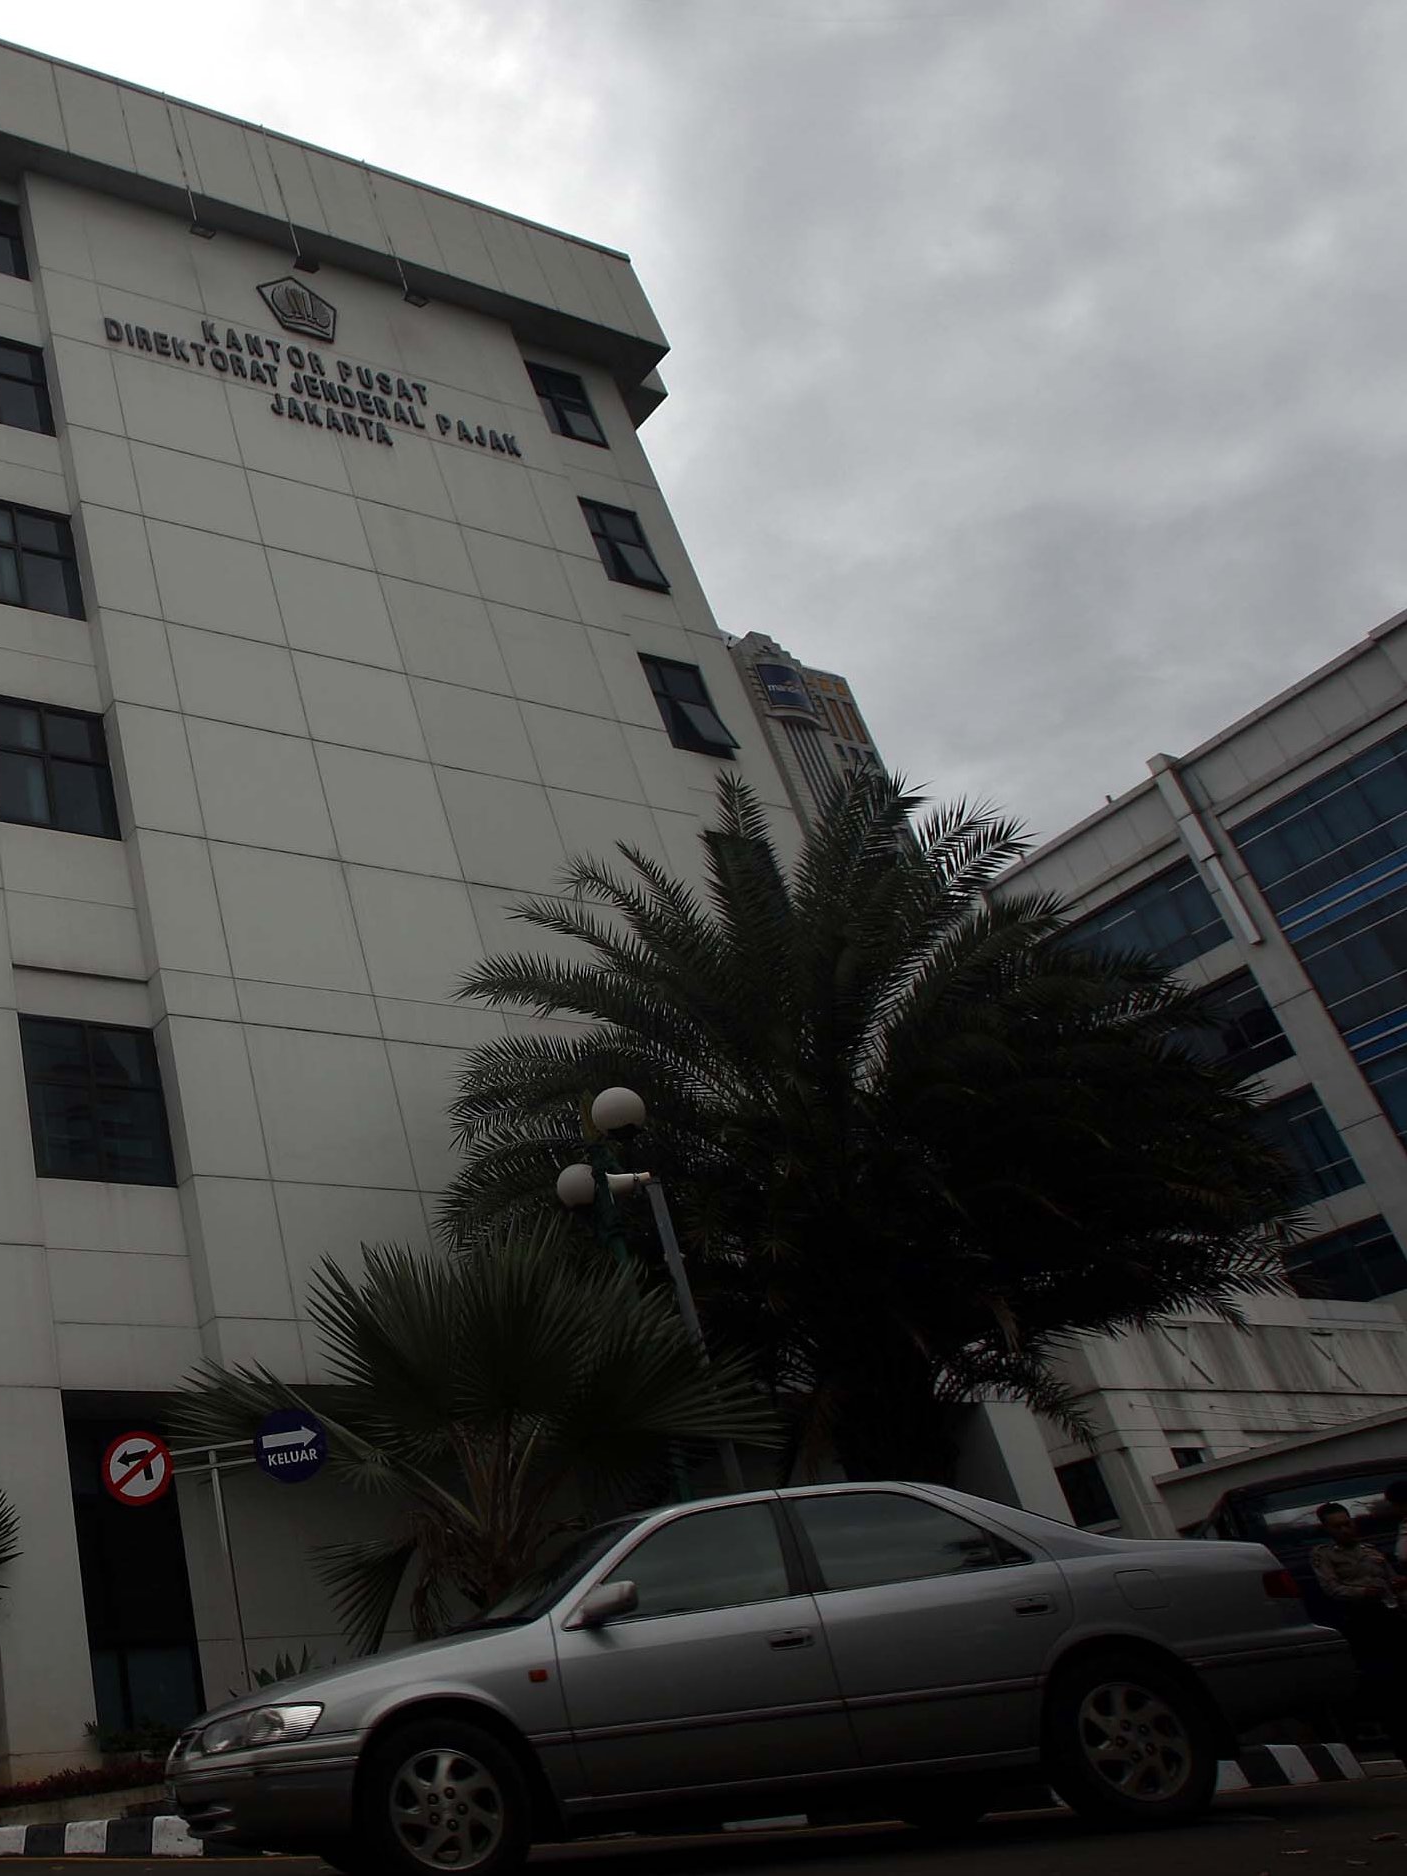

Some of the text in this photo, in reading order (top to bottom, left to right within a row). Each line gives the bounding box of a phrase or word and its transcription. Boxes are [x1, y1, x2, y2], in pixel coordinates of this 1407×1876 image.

[104, 316, 522, 458] DIREKTORAT JENDERAL PAJAK
[201, 319, 428, 406] KANTOR PUSAT
[270, 393, 394, 446] JAKARTA
[267, 1448, 318, 1467] KELUAR
